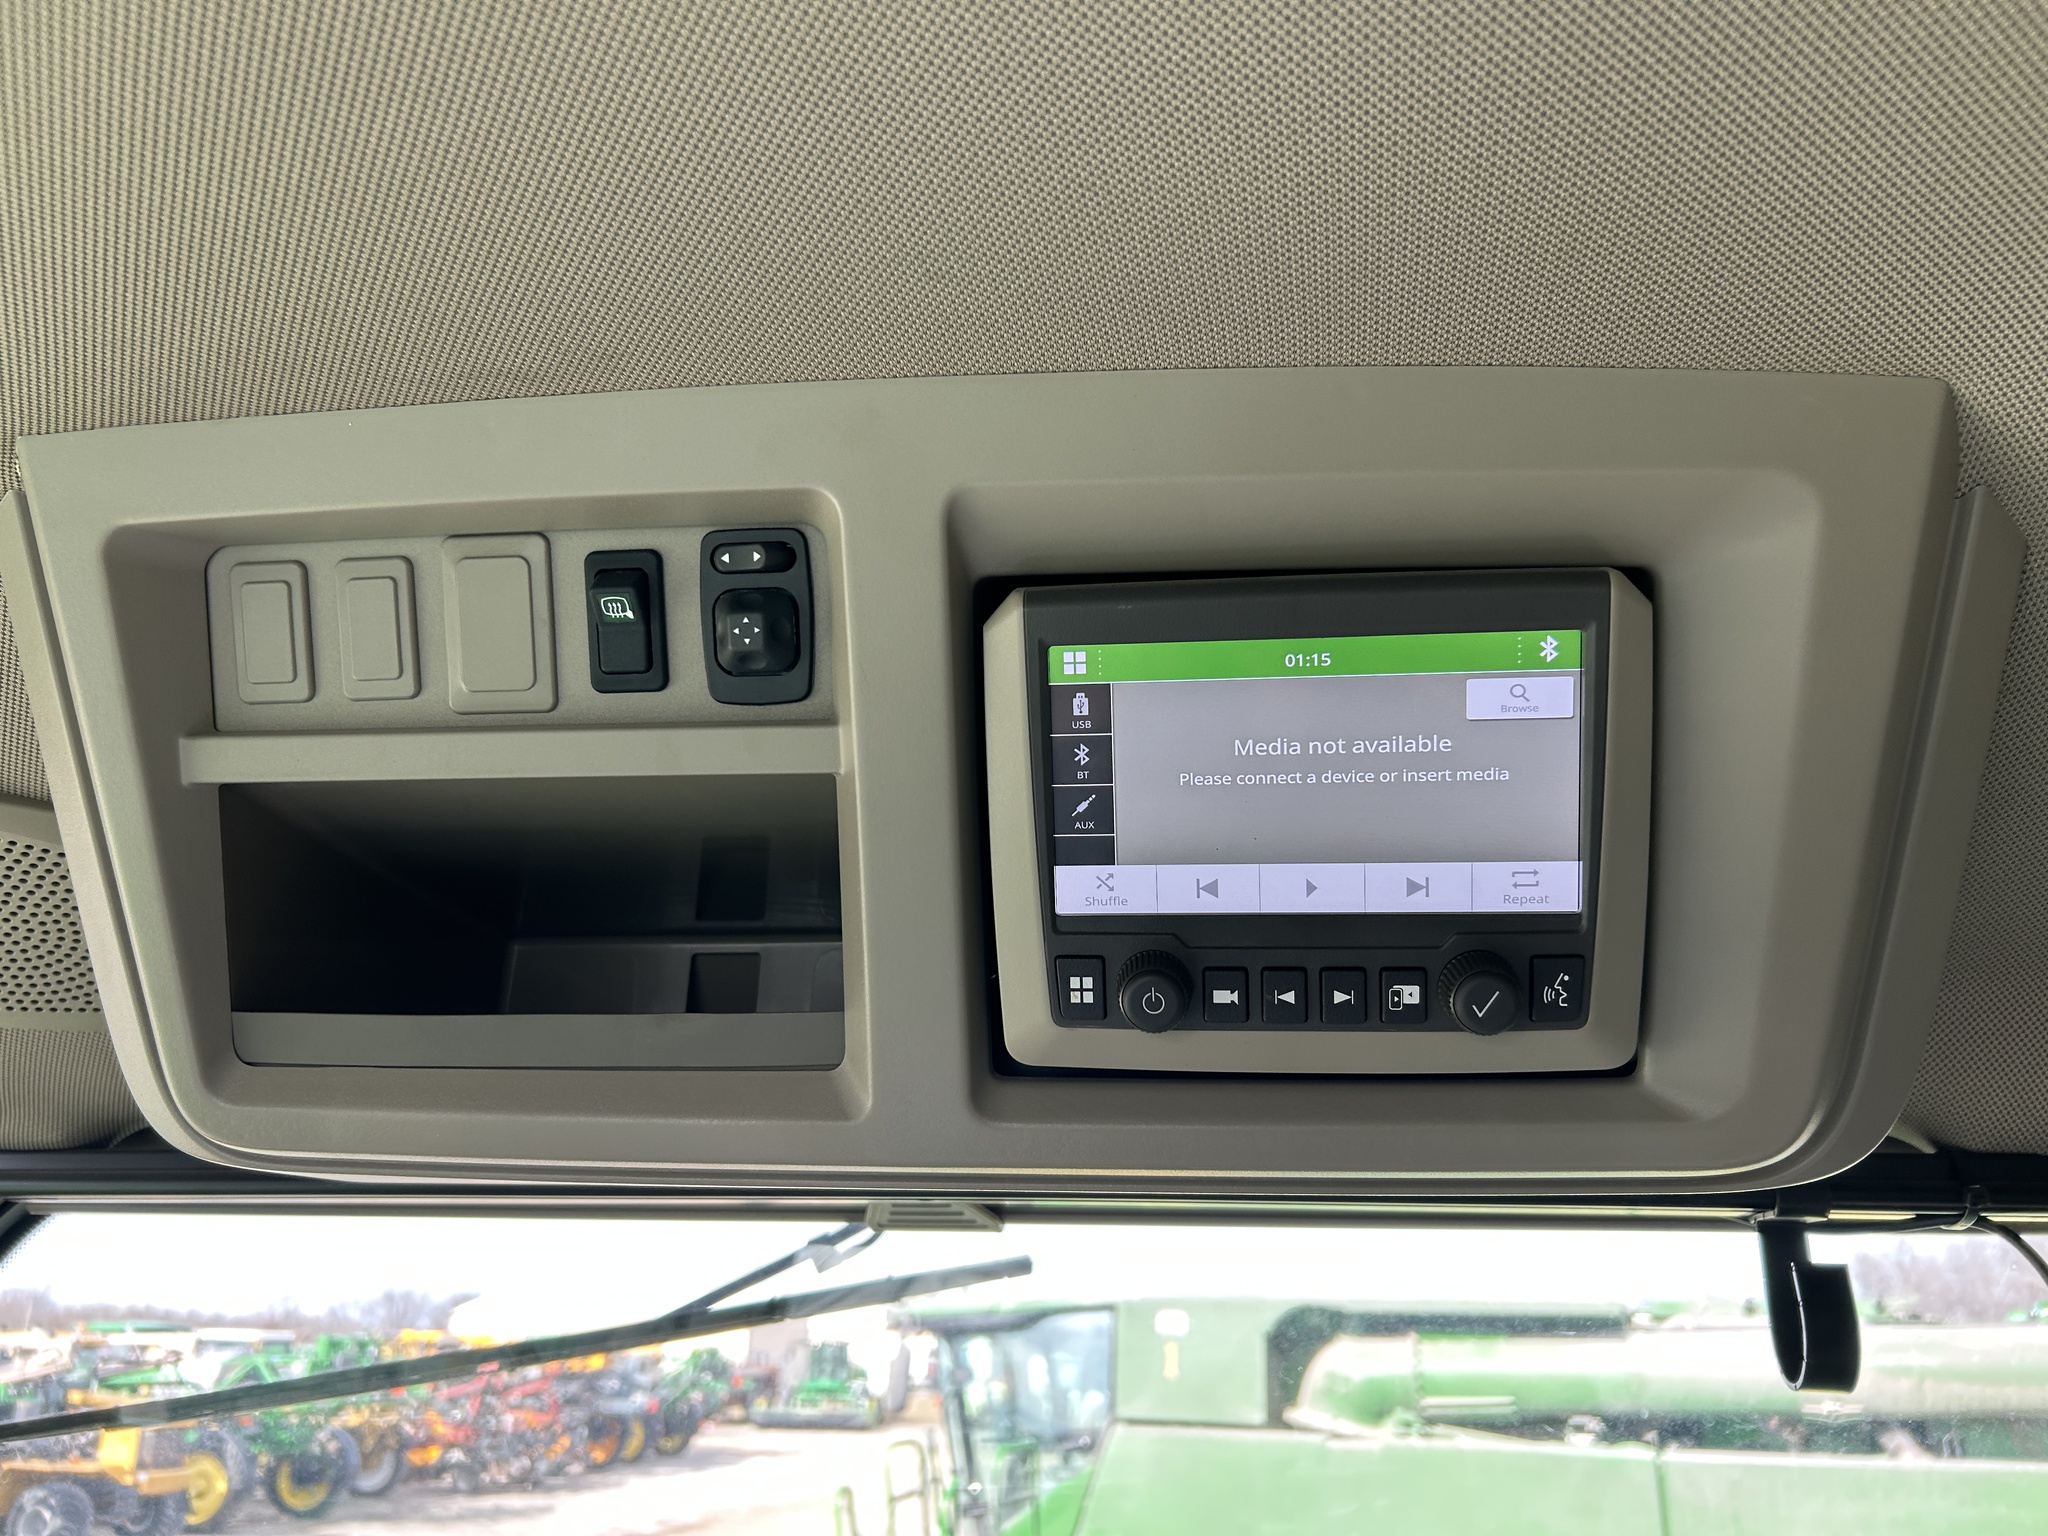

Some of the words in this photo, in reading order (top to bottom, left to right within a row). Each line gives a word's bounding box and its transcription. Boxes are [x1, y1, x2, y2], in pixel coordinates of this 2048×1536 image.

[1285, 653, 1331, 667] 01:15
[1500, 704, 1539, 713] Browse
[1072, 720, 1092, 729] USB
[1234, 737, 1301, 756] Media
[1308, 737, 1346, 754] not
[1352, 734, 1452, 753] available
[1077, 771, 1089, 779] BT
[1179, 772, 1232, 786] Please
[1236, 771, 1301, 785] connect
[1305, 773, 1316, 784] a
[1321, 769, 1375, 783] device
[1379, 772, 1398, 783] or
[1403, 768, 1451, 783] insert
[1457, 767, 1509, 781] media
[1075, 820, 1095, 829] AUX
[1085, 894, 1128, 906] Shuffle
[1503, 893, 1549, 906] Repeat
